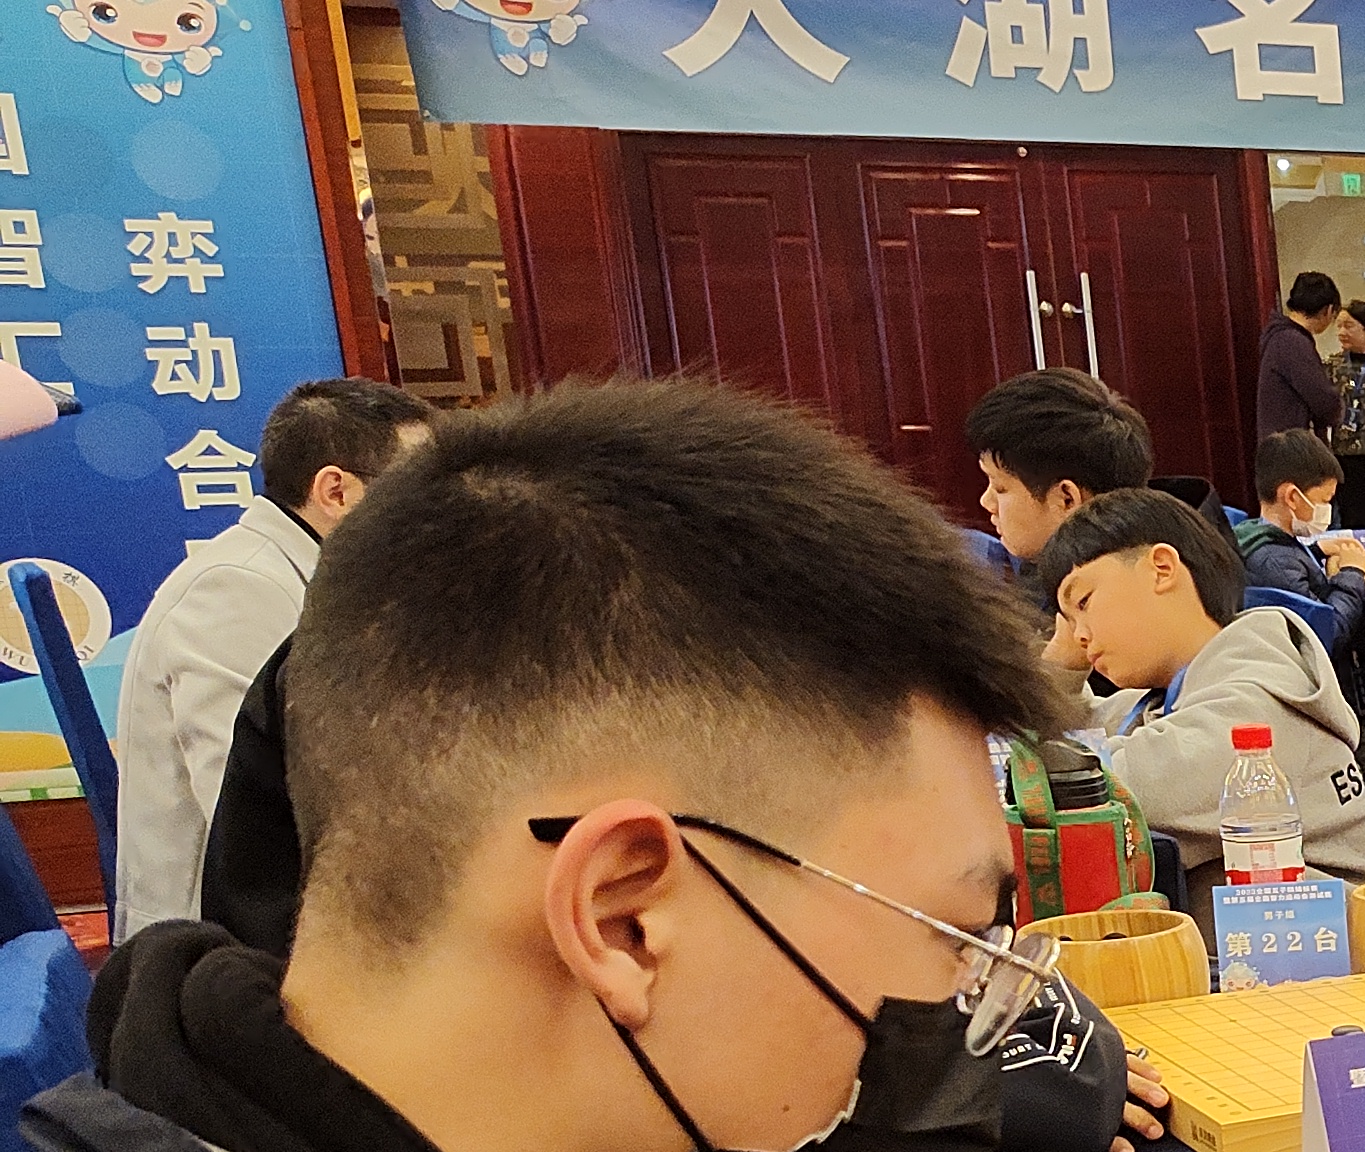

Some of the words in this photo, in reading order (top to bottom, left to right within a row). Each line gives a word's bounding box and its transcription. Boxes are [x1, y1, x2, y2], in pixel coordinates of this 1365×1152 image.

[123, 211, 257, 556] 弈动合
[1225, 926, 1338, 958] 第22台
